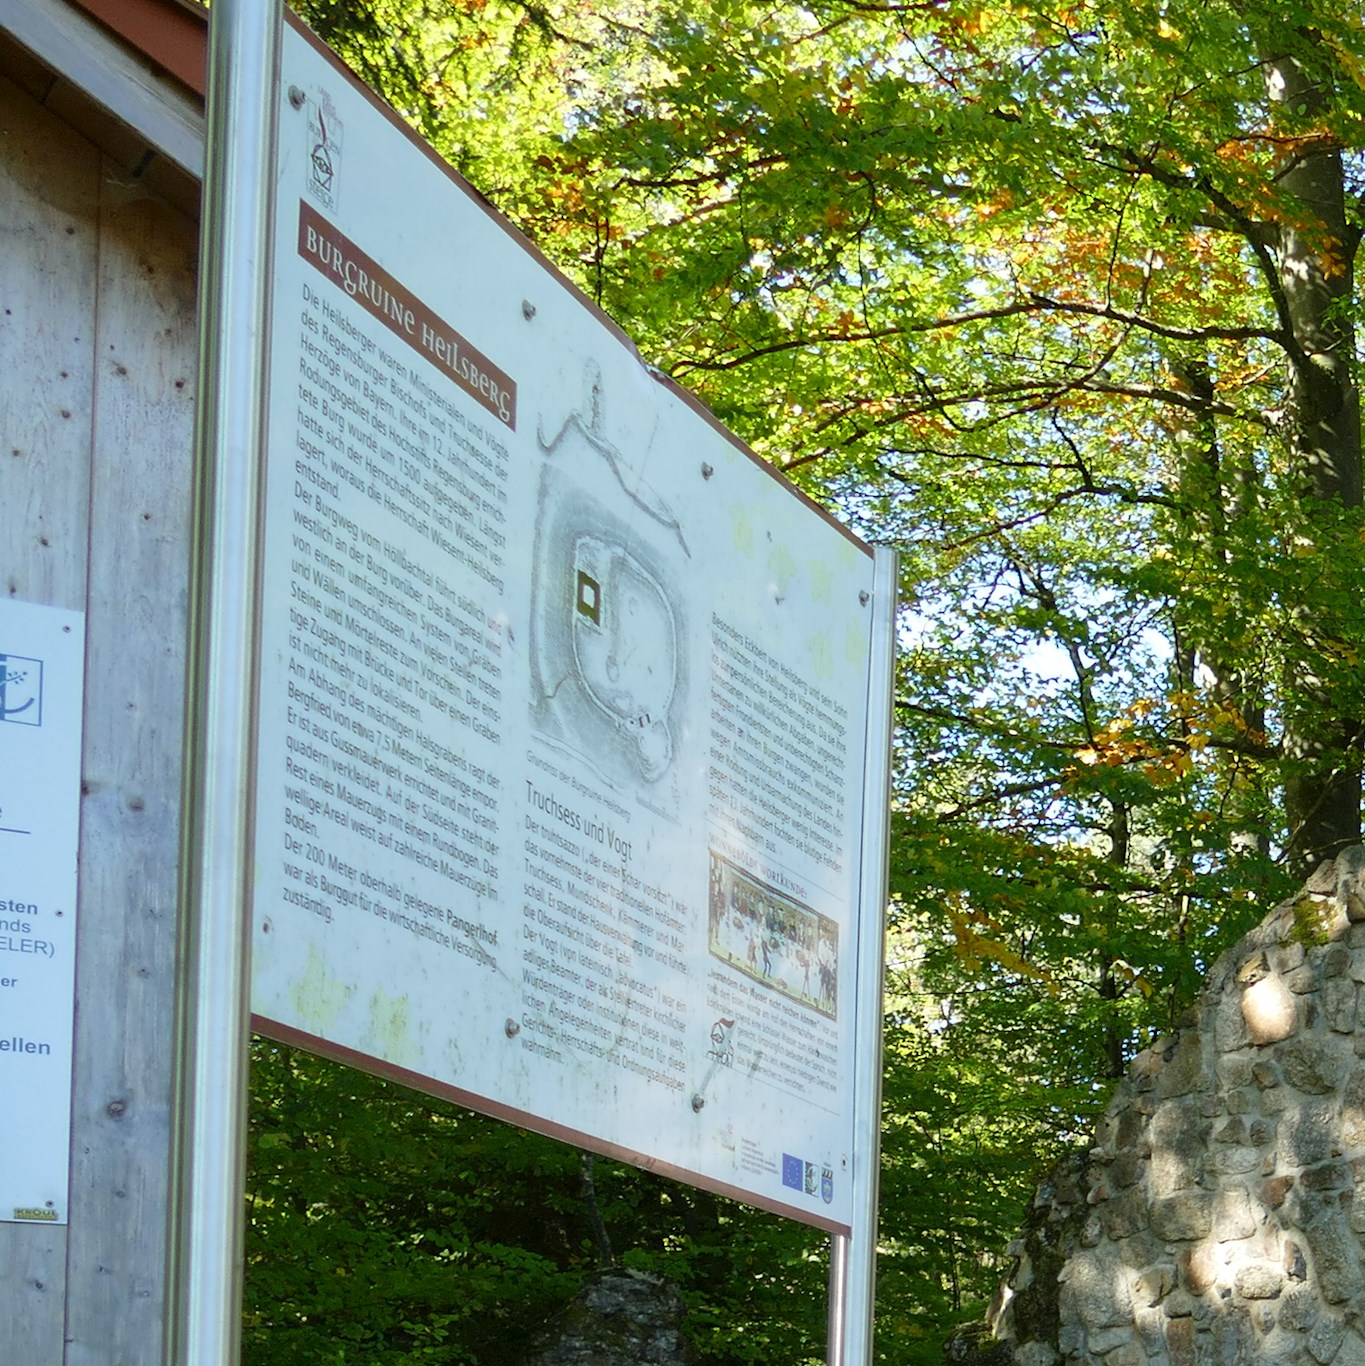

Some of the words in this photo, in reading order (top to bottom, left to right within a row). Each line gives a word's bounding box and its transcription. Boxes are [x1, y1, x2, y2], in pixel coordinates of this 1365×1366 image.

[302, 283, 319, 311] Die
[321, 298, 376, 355] Heilsberger
[379, 348, 407, 381] waren
[410, 370, 466, 427] Ministerialen
[467, 419, 483, 441] und
[485, 430, 509, 462] Vögte
[306, 226, 415, 334] BURGRUINE
[422, 323, 511, 422] HEILSBERG
[300, 332, 340, 378] Herzöge
[343, 369, 361, 393] von
[362, 380, 396, 421] Bayern.
[400, 409, 417, 436] Ihre
[446, 445, 495, 496] Jahrhundert
[301, 306, 318, 336] des
[322, 324, 388, 389] Regensburger
[390, 378, 426, 420] Bischofs
[429, 412, 445, 435] und
[448, 423, 492, 472] Truchsesse
[495, 459, 508, 484] der
[295, 459, 341, 502] entstand.
[296, 404, 324, 440] hatte
[326, 430, 345, 455] sich
[347, 440, 362, 467] der
[364, 455, 430, 516] Herrschaftssitz
[432, 508, 453, 533] nach
[455, 521, 488, 558] Wiesent
[489, 550, 505, 570] ver-
[296, 429, 328, 471] lagert,
[331, 459, 365, 494] woraus
[367, 480, 381, 505] die
[383, 493, 429, 539] Herrschaft
[431, 527, 504, 597] Wiesent-Heilsberg
[298, 381, 319, 411] tete
[321, 398, 344, 435] Burg
[348, 422, 378, 454] wurde
[380, 446, 395, 467] um
[398, 456, 421, 486] 1500
[423, 478, 476, 527] aufgegeben.
[479, 516, 505, 549] Längst
[293, 509, 333, 546] westlich
[335, 536, 347, 555] an
[349, 540, 364, 566] der
[366, 554, 387, 587] Burg
[389, 573, 425, 607] vorüber.
[427, 594, 443, 619] Das
[445, 606, 483, 646] Burgareal
[485, 637, 501, 658] wird
[294, 480, 312, 507] Der
[314, 494, 358, 543] Burgweg
[361, 530, 381, 553] vom
[383, 541, 433, 589] Höllbachtal
[436, 575, 456, 604] führt
[457, 594, 486, 624] südlich
[487, 616, 502, 636] und
[284, 807, 319, 839] Boden.
[285, 734, 329, 768] quadern
[332, 759, 382, 797] verkleidet.
[386, 784, 402, 807] Auf
[404, 792, 419, 816] der
[421, 802, 459, 837] Südseite
[461, 827, 483, 849] steht
[485, 835, 498, 857] der
[285, 756, 308, 783] Rest
[309, 771, 334, 796] eines
[337, 783, 387, 826] Mauerzugs
[388, 813, 403, 831] mit
[405, 820, 431, 845] einem
[432, 832, 480, 871] Rundbogen.
[483, 858, 498, 880] Das
[526, 778, 581, 831] Truchsess
[583, 819, 604, 844] und
[607, 827, 632, 863] Vogt
[0, 900, 38, 915] sten
[0, 919, 31, 934] nds
[283, 832, 303, 856] Der
[305, 842, 325, 867] 200
[328, 853, 358, 882] Meter
[359, 869, 401, 902] oberhalb
[403, 892, 444, 923] gelegene
[446, 909, 497, 947] Pangerlhof
[283, 887, 334, 925] zuständig.
[0, 1036, 50, 1055] ellen
